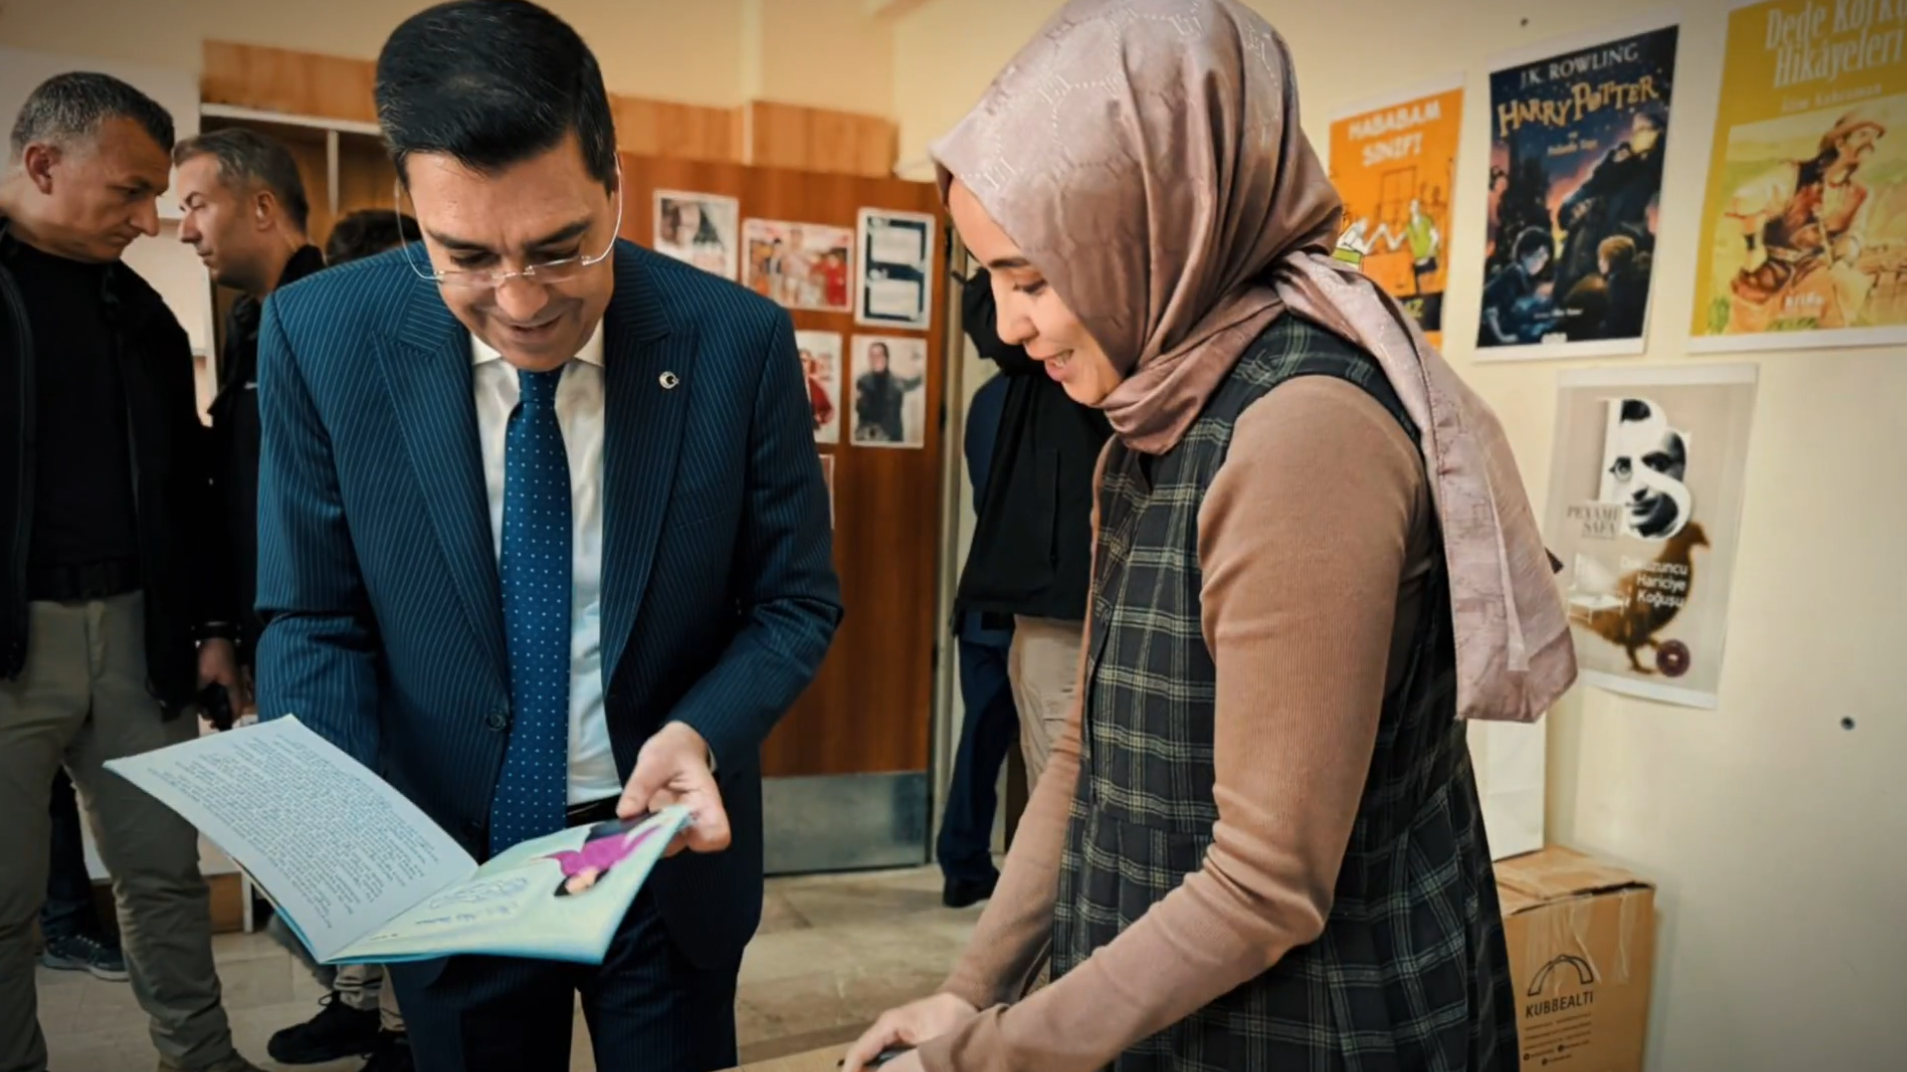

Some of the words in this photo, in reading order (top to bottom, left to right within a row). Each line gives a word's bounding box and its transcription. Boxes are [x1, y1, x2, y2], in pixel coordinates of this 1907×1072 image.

[1766, 1, 1827, 50] Dede
[1549, 43, 1639, 80] ROWLING
[1497, 97, 1573, 138] HARRY
[1571, 74, 1660, 122] POTTER
[1524, 990, 1594, 1018] KUBBEALTI
